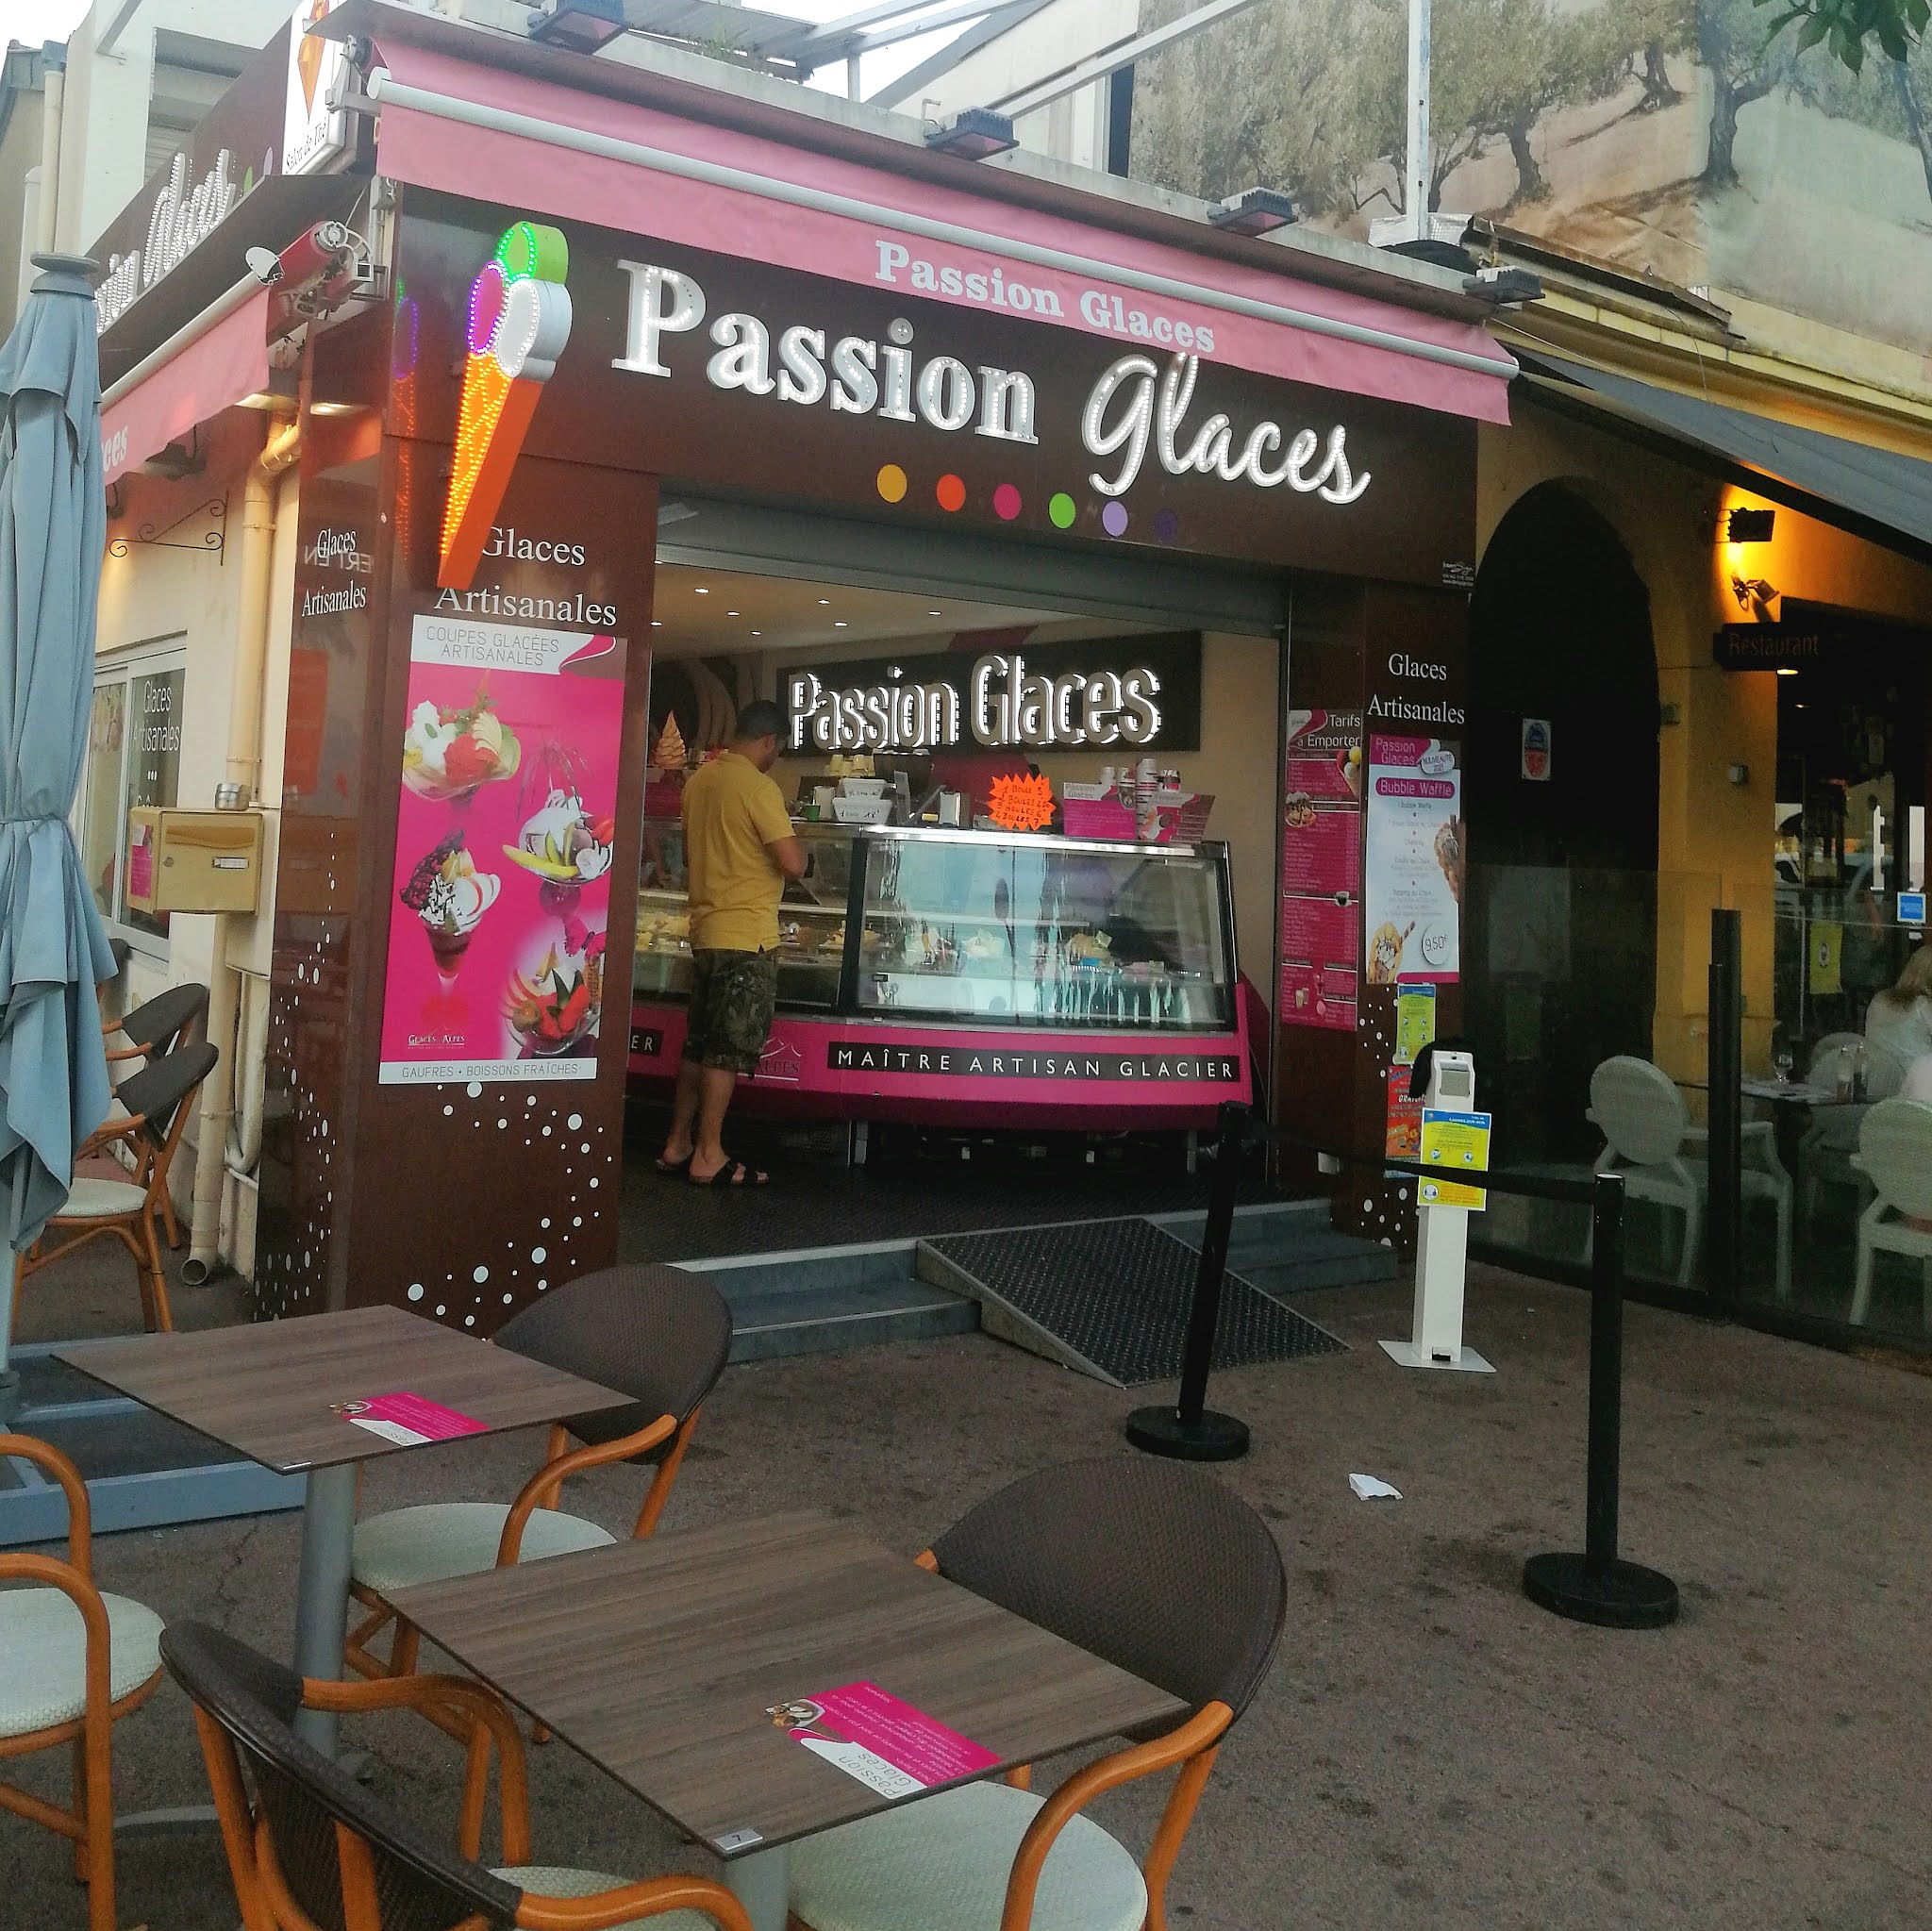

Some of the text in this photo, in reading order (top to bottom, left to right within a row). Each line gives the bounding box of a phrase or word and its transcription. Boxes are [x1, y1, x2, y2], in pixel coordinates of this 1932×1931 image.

[874, 240, 1216, 353] Passion Glaces
[611, 258, 1040, 445] Passion
[317, 528, 357, 558] Glaces
[481, 525, 587, 566] Glaces
[302, 580, 367, 617] Artisanales
[434, 585, 617, 626] Artisanales
[426, 625, 559, 655] COUPES GLACÉES
[441, 643, 544, 667] ARTISANALES
[1388, 653, 1447, 680] Glaces
[144, 680, 172, 713] Glaces
[788, 654, 1163, 751] Passion Glaces
[1367, 693, 1465, 724] Artisanales
[1329, 714, 1360, 727] Tarifs
[1307, 734, 1360, 749] Emporter
[1375, 737, 1416, 753] Passion
[1381, 751, 1416, 766] Glaces
[1380, 779, 1453, 796] Bubble Waffle
[402, 1061, 579, 1079] GAUFRES BOISSONS FRAÎCHES
[837, 1048, 1233, 1078] MAÎTRE ARTISAN GLACIER
